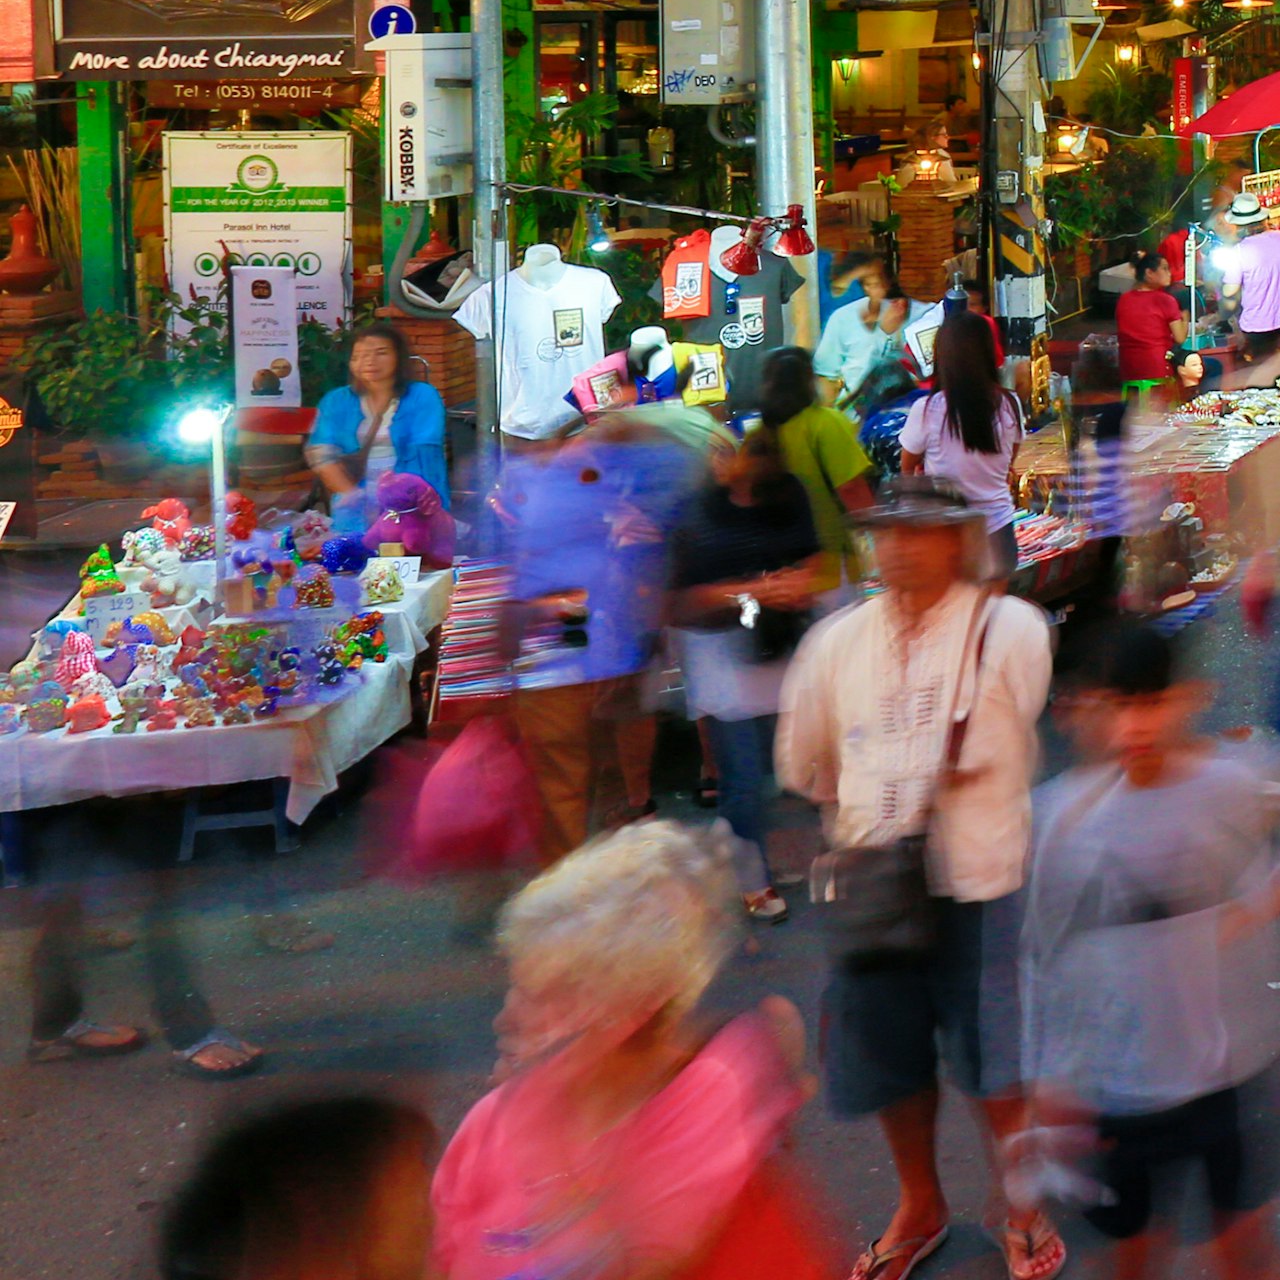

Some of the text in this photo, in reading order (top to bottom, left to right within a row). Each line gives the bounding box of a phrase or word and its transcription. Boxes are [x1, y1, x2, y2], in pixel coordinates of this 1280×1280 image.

[138, 46, 210, 69] about
[214, 42, 345, 77] Chiangmai
[174, 84, 198, 98] Tel
[216, 84, 255, 100] (053)
[261, 84, 334, 99] 814011-4
[216, 142, 298, 150] Certificate of Excellence
[223, 223, 291, 231] Parasol Inn Hotel
